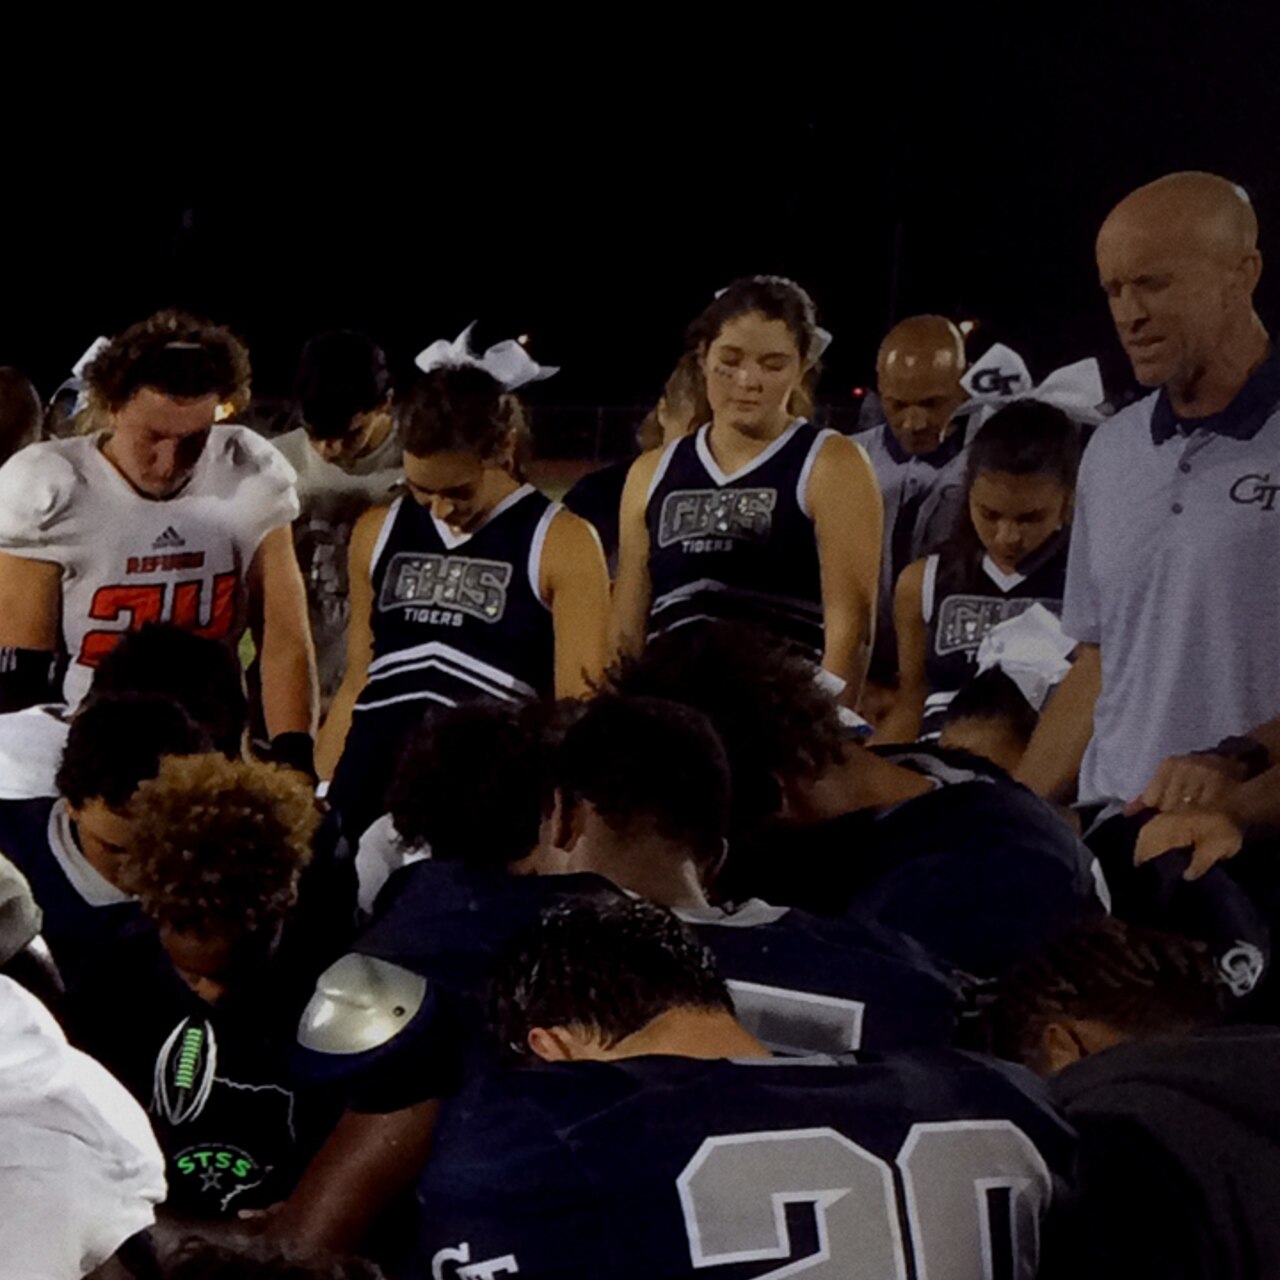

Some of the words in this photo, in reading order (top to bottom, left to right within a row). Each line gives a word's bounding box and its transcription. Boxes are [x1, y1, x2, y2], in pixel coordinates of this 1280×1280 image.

[972, 367, 1021, 396] GT
[1229, 474, 1280, 511] GT
[403, 607, 464, 627] TIGERS
[176, 1150, 252, 1179] STSS
